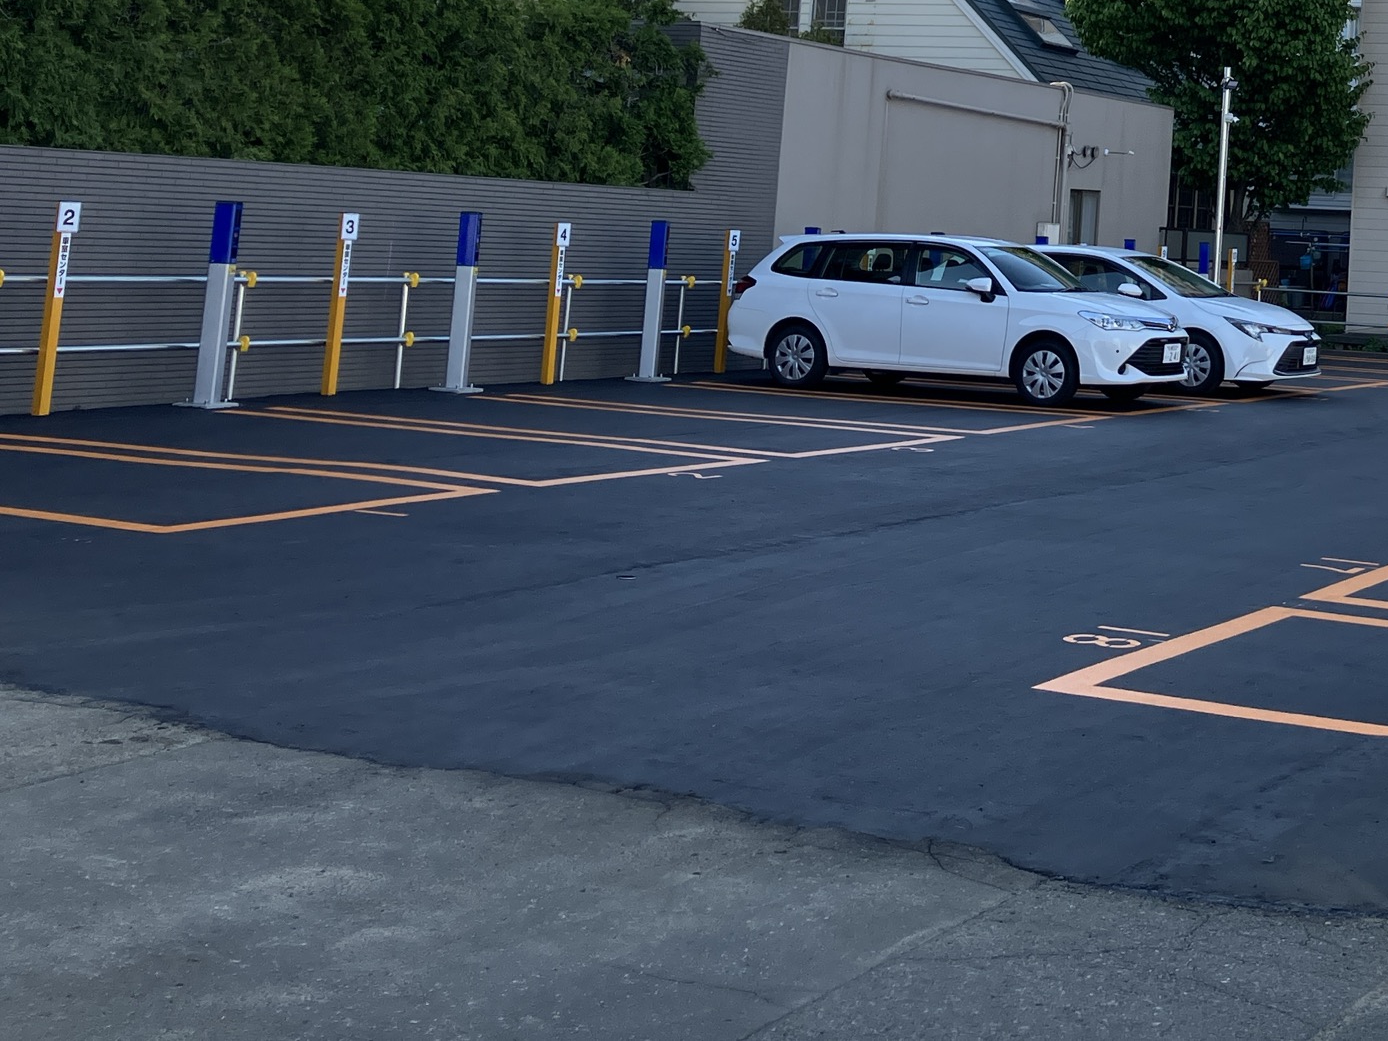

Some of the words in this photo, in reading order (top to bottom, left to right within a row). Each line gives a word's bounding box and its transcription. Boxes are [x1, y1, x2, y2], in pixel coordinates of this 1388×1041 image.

[63, 209, 75, 226] 2
[346, 220, 355, 234] 3
[560, 228, 568, 242] 4
[731, 234, 738, 247] 5
